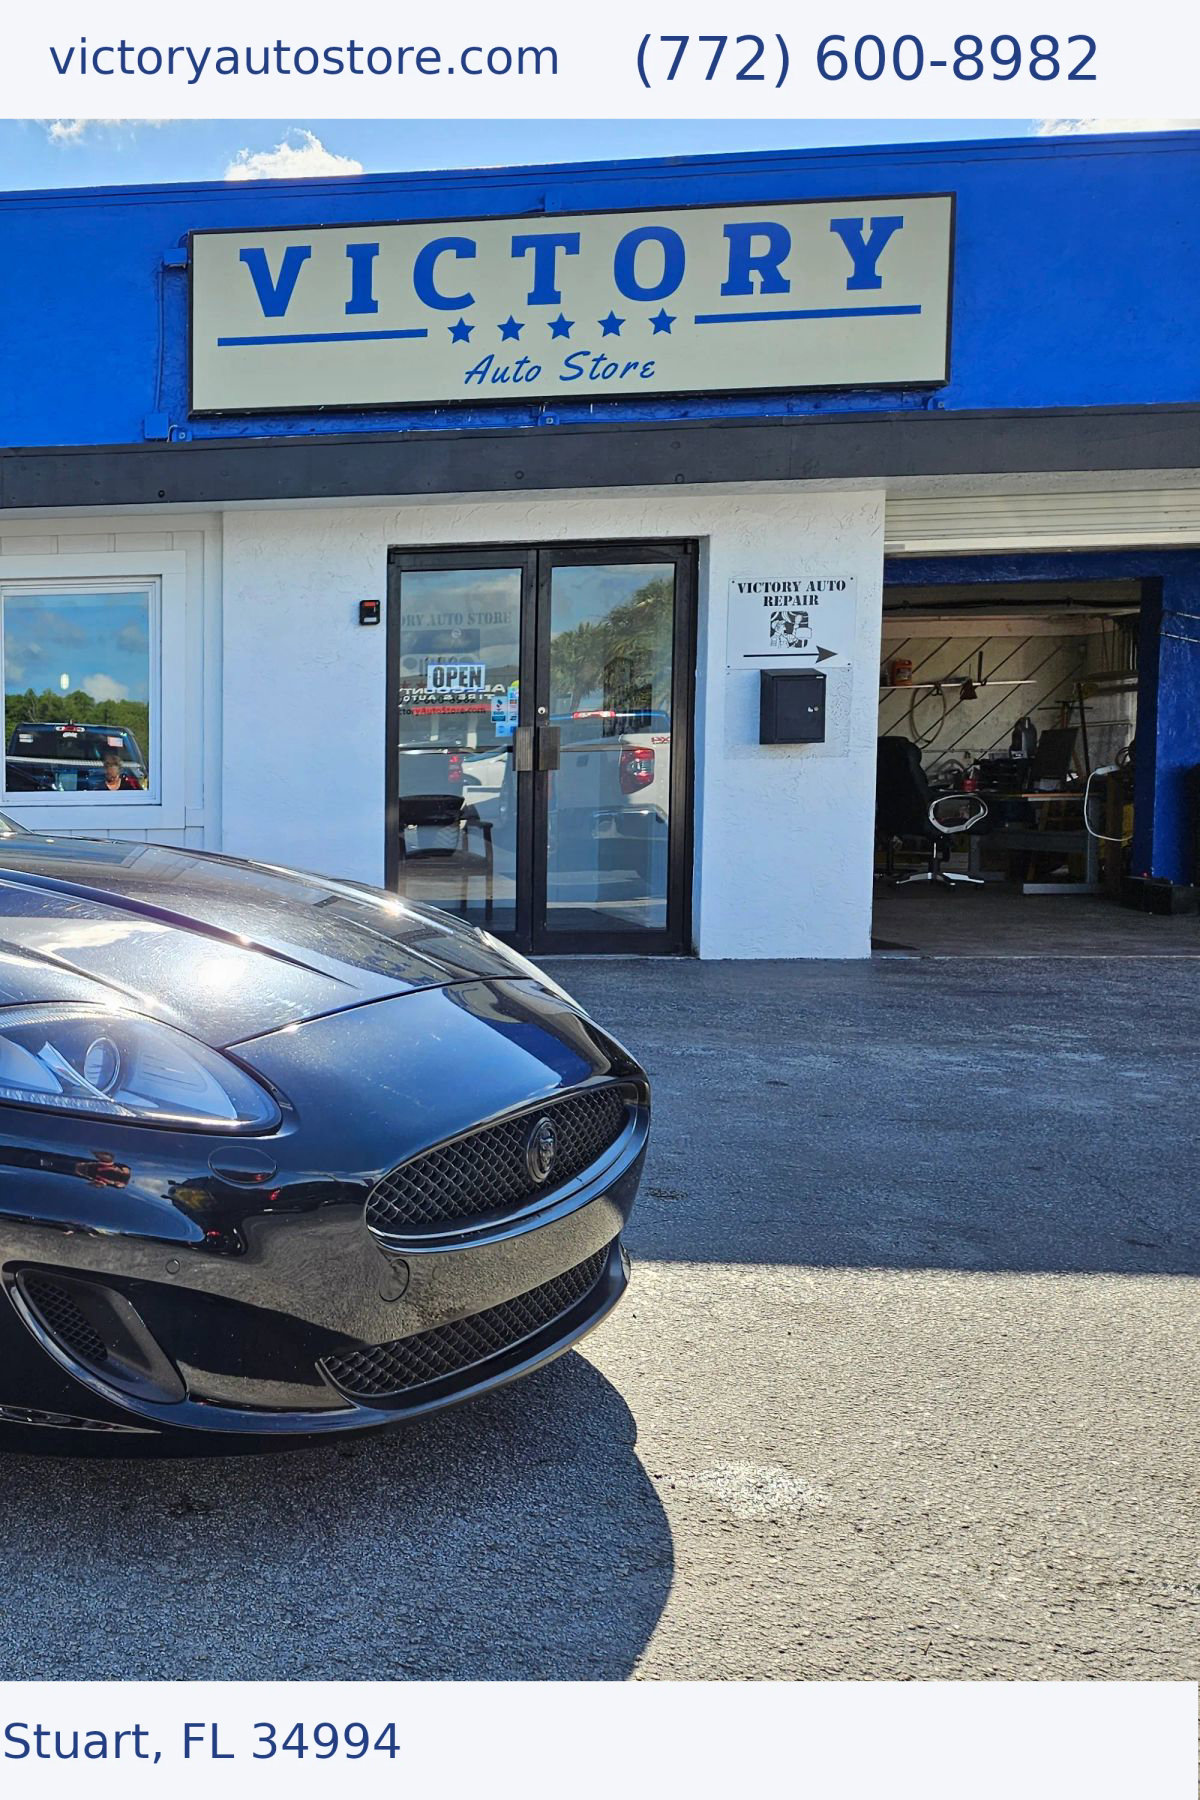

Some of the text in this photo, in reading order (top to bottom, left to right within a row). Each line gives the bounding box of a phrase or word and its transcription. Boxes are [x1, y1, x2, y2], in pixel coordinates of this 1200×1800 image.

[239, 215, 905, 317] VICTORY
[464, 350, 656, 385] Auto Store
[738, 580, 846, 593] VICTORY AUTO
[763, 595, 819, 607] REPAIR
[427, 612, 463, 626] AUTO
[467, 611, 512, 626] STORE
[432, 666, 482, 688] OPEN
